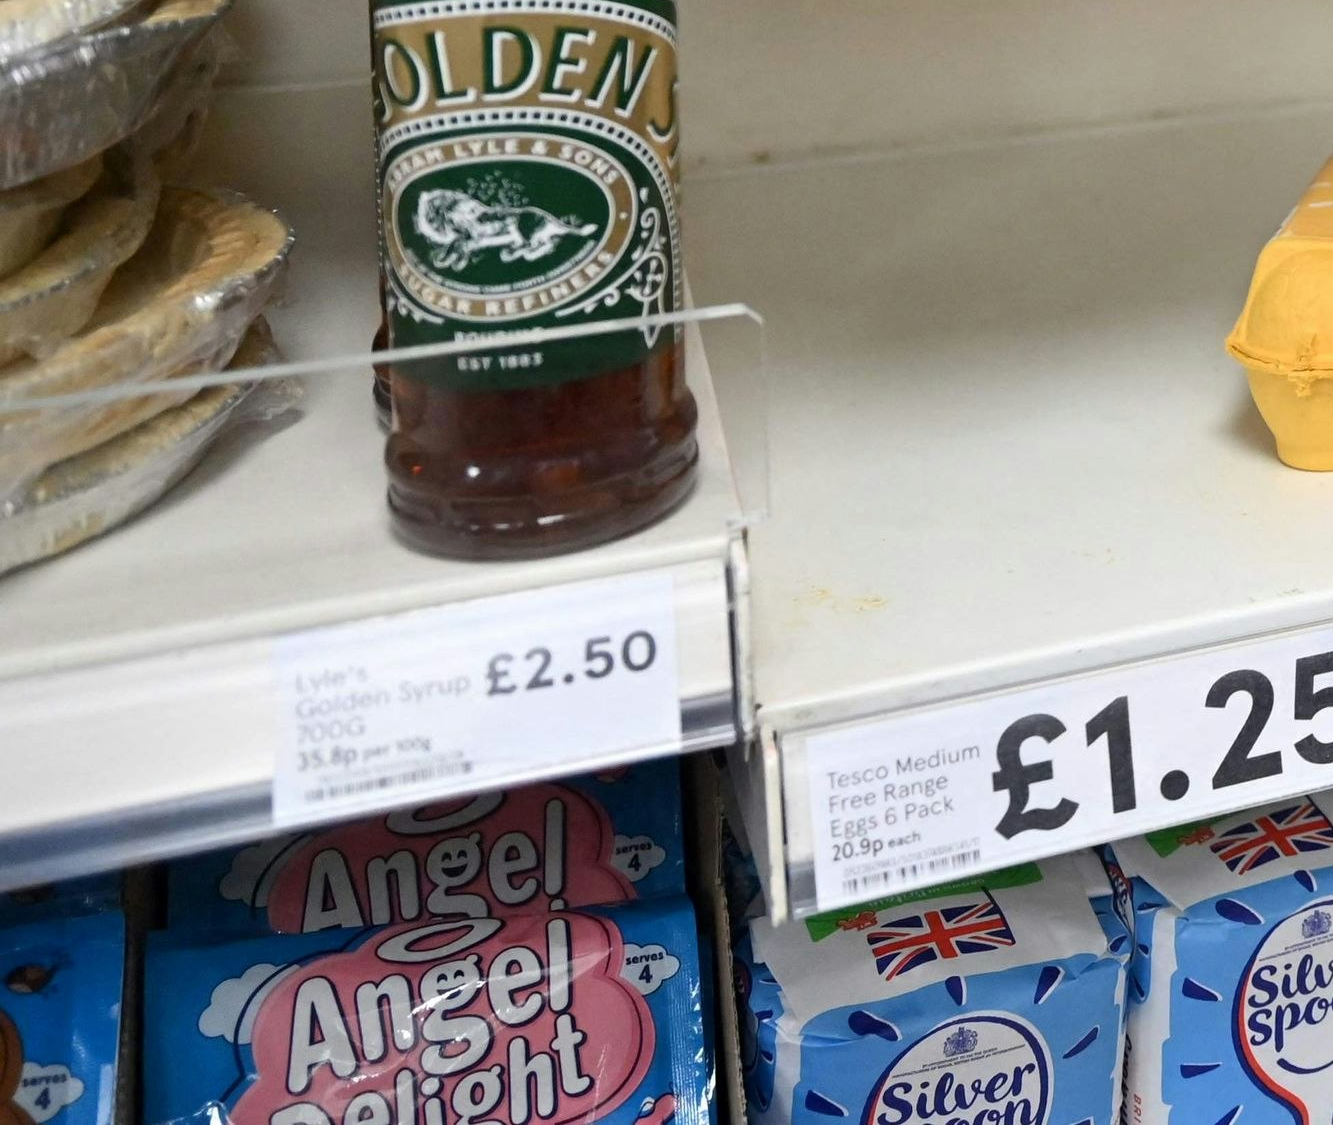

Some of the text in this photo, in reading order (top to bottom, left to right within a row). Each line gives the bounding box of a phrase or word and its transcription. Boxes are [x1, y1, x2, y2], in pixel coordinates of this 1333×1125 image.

[380, 26, 658, 124] OLDEN
[453, 138, 620, 185] LYLE & SONS
[484, 251, 615, 316] REFINERS
[484, 629, 658, 698] £2.50
[295, 673, 472, 721] Golden Syrup
[296, 715, 366, 743] 700G
[297, 744, 359, 774] 35.8p
[362, 742, 391, 761] per
[827, 745, 981, 790] Tesco Medium
[828, 775, 949, 814] Free Range
[830, 795, 955, 840] Eggs 6 Pack
[300, 797, 568, 935] Angel
[614, 840, 654, 858] serves
[626, 854, 643, 873] 4
[832, 838, 884, 863] 20.9p
[887, 830, 922, 848] each
[623, 950, 665, 970] serves
[637, 963, 655, 985] 4
[285, 917, 575, 1096] Angel
[269, 1012, 594, 1125] elight
[34, 1087, 52, 1111] 4
[877, 1061, 1037, 1125] Silver
